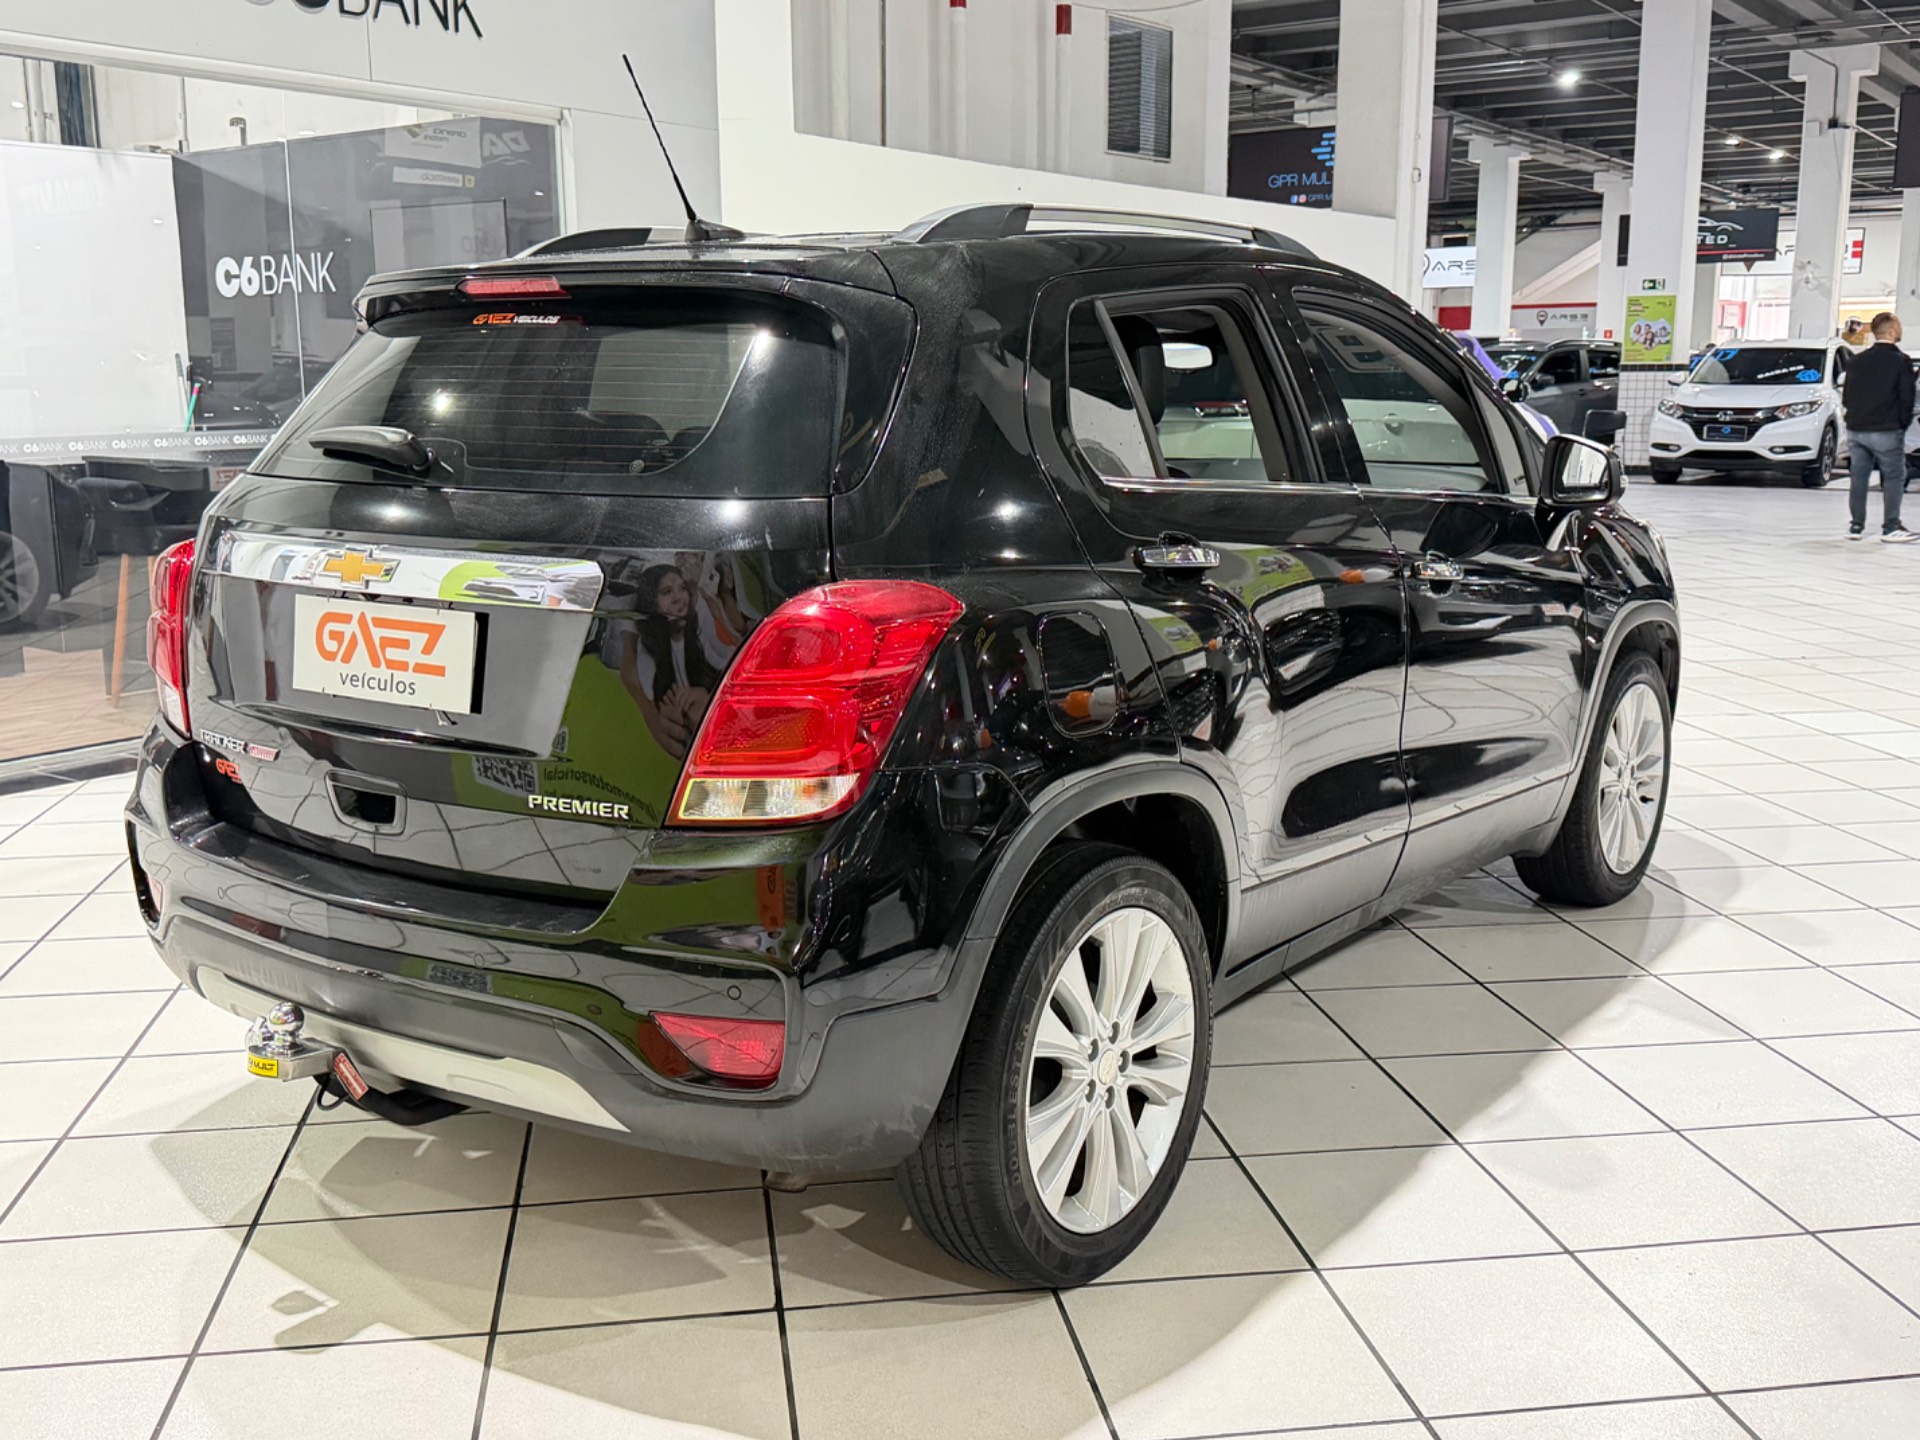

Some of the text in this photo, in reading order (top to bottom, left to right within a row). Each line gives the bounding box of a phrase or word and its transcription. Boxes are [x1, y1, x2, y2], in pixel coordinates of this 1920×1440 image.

[1267, 173, 1299, 188] GPR
[215, 251, 337, 298] C6BANK
[23, 441, 65, 454] C6BANK
[68, 440, 108, 451] C6BANK
[112, 438, 150, 449] C6BANK
[154, 437, 192, 447] C6BANK
[194, 435, 230, 446] C6BANK
[233, 434, 269, 444] C6BANK
[315, 611, 447, 677] GAEZ
[339, 671, 417, 696] veículos
[527, 794, 630, 820] PREMIER
